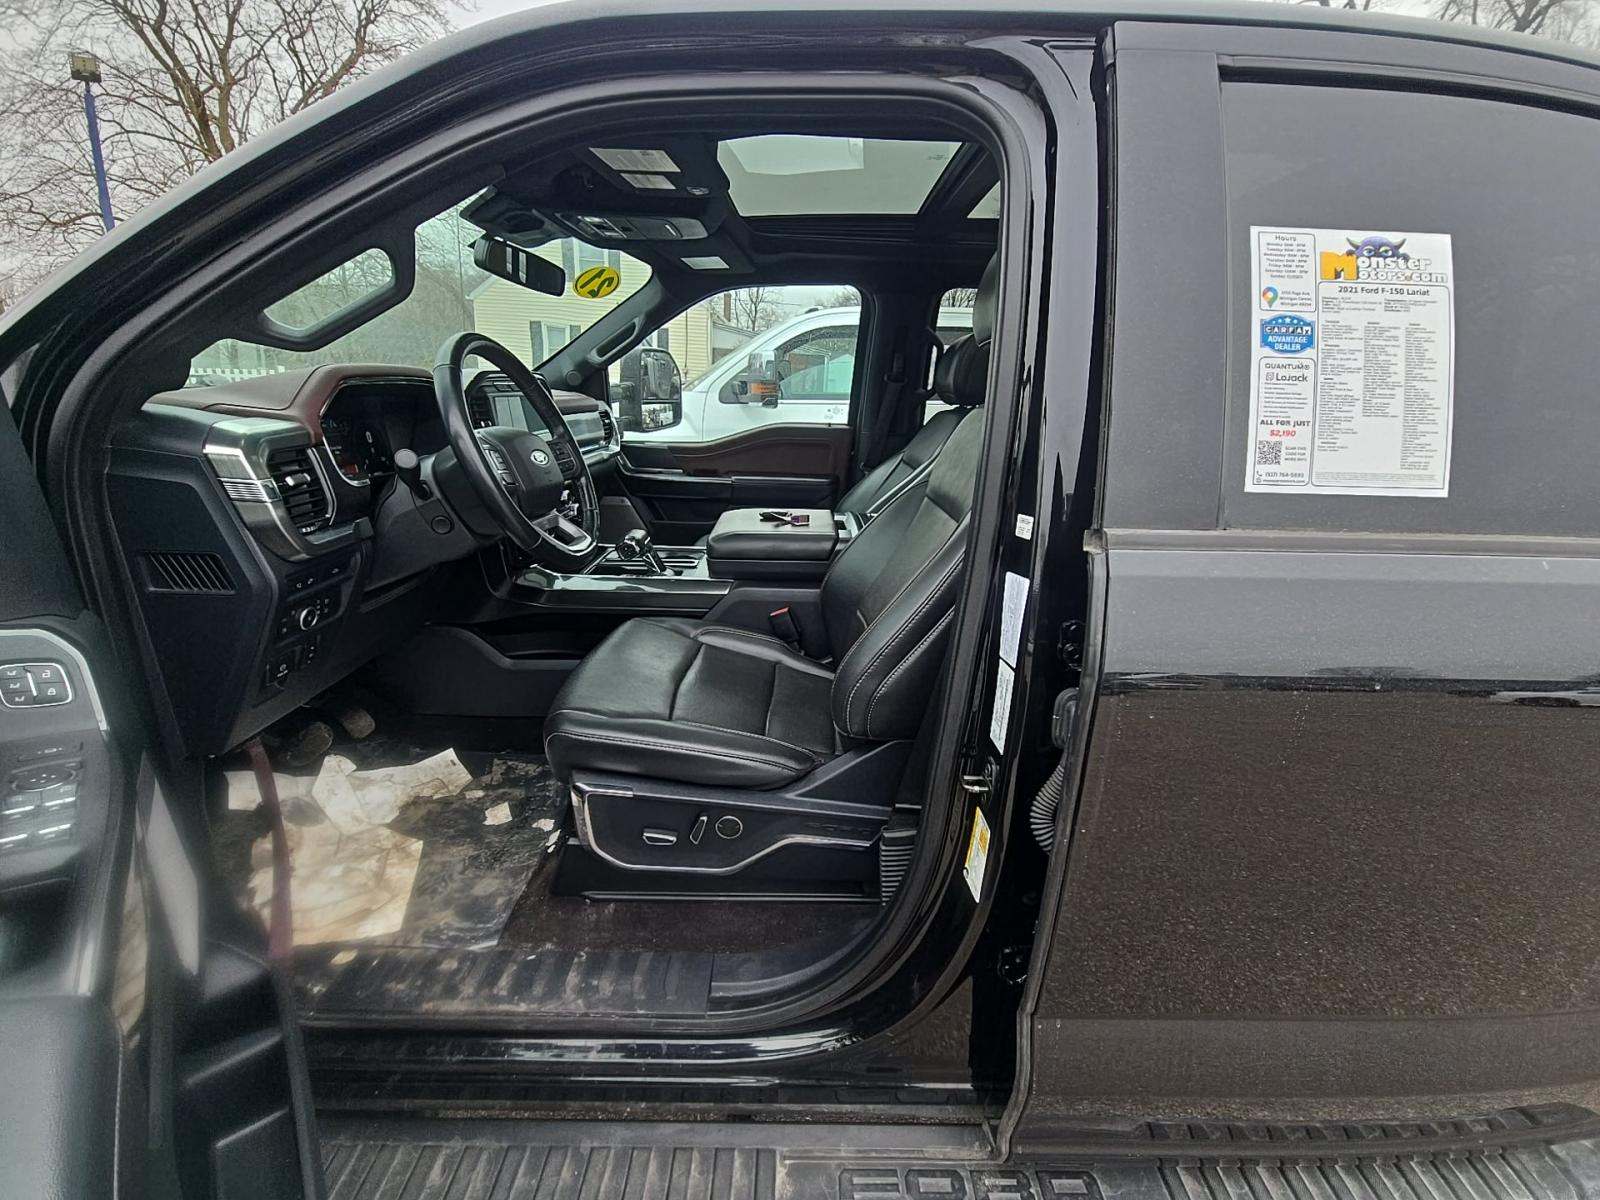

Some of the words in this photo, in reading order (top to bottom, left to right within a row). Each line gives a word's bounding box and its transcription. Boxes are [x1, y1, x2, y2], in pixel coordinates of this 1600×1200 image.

[1338, 285, 1358, 294] 2021
[1360, 286, 1379, 294] Ford
[1381, 287, 1405, 295] F-150
[1406, 288, 1430, 296] Lariat
[1265, 326, 1311, 334] CARFAX
[1267, 335, 1308, 343] ADVANTAGE
[1269, 429, 1297, 437] $2,190
